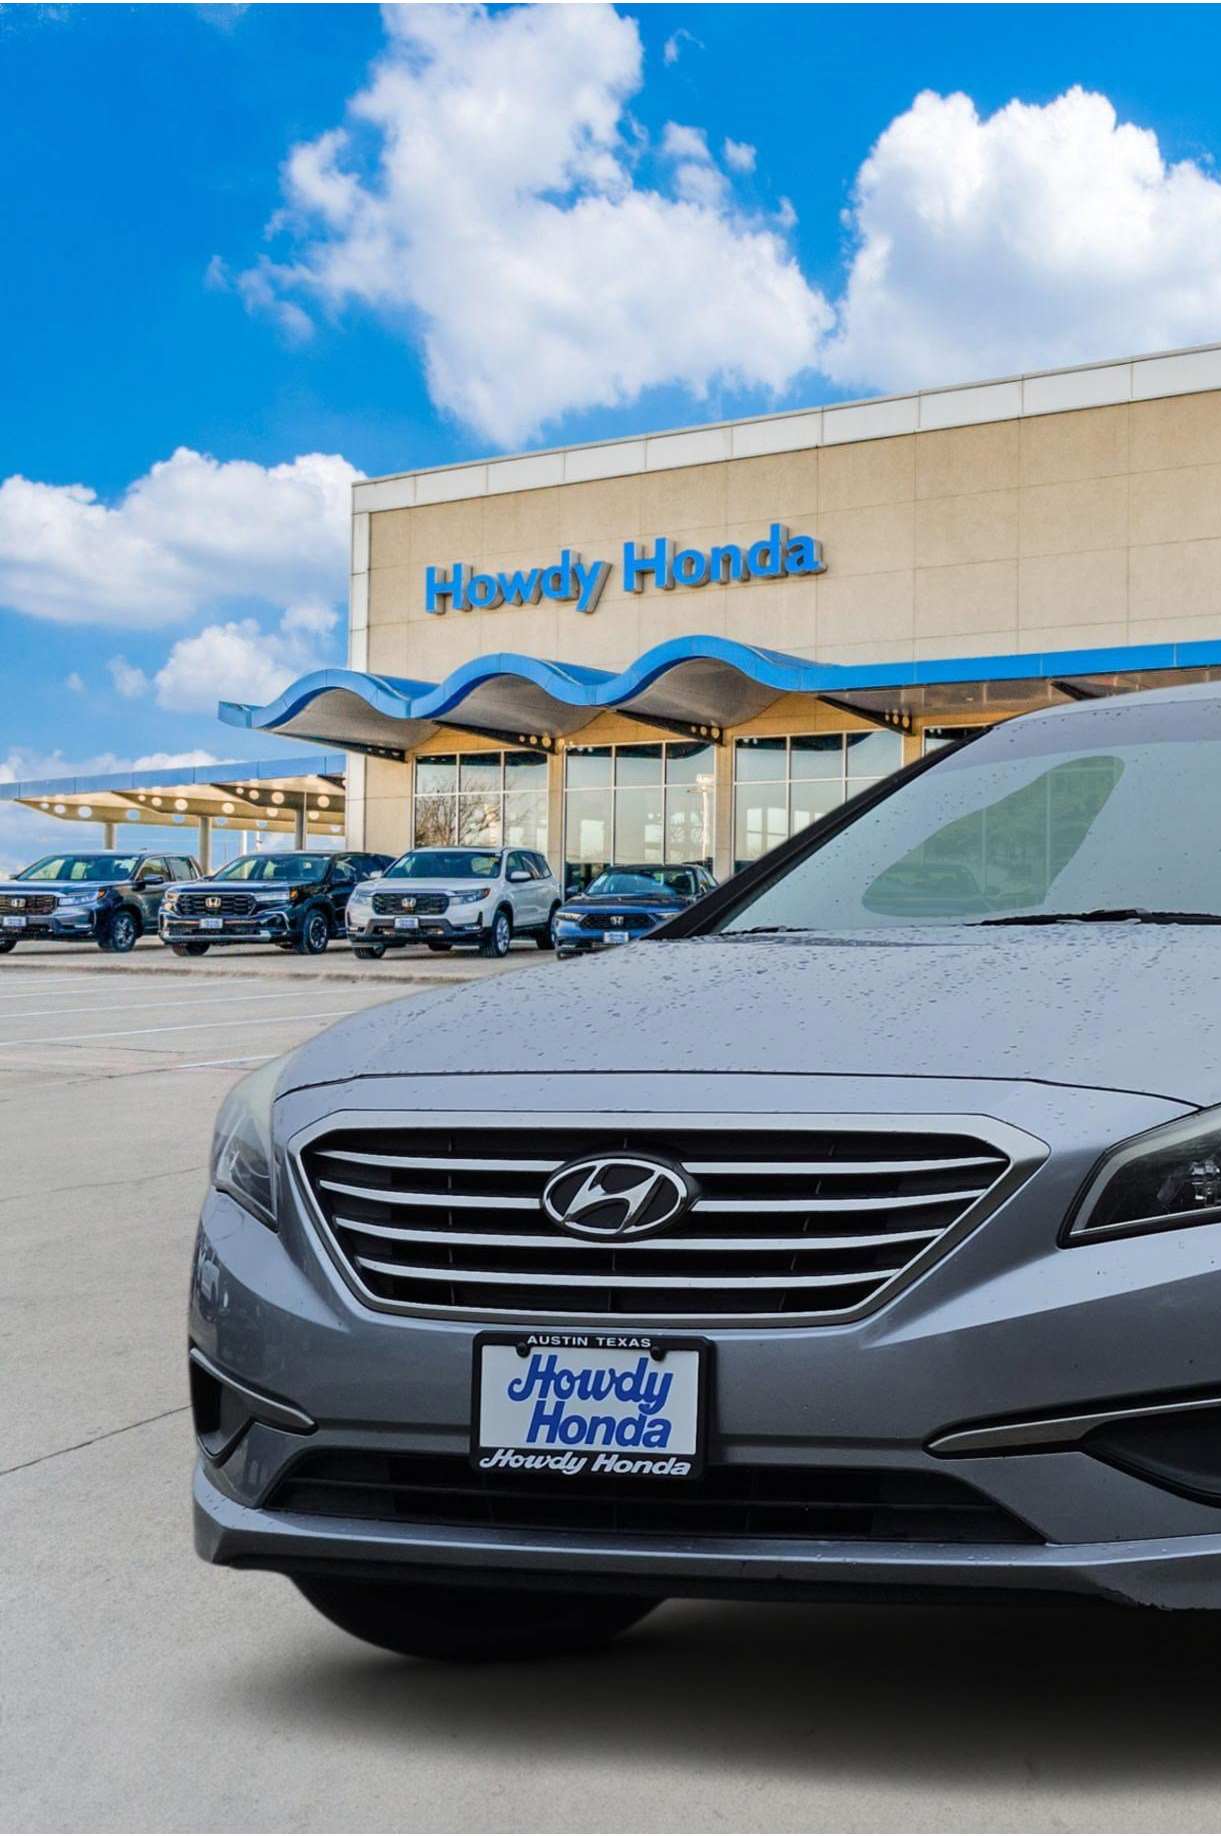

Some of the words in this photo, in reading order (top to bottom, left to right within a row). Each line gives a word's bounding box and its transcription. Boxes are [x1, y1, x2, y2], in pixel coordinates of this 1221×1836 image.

[425, 549, 611, 613] Howdy
[623, 523, 826, 593] Honda
[527, 1335, 588, 1346] AUSTIN
[596, 1337, 651, 1348] TEXAS
[507, 1354, 673, 1414] Howdy
[527, 1401, 672, 1448] Honda
[479, 1449, 588, 1475] Howdy
[592, 1453, 691, 1476] Honda
